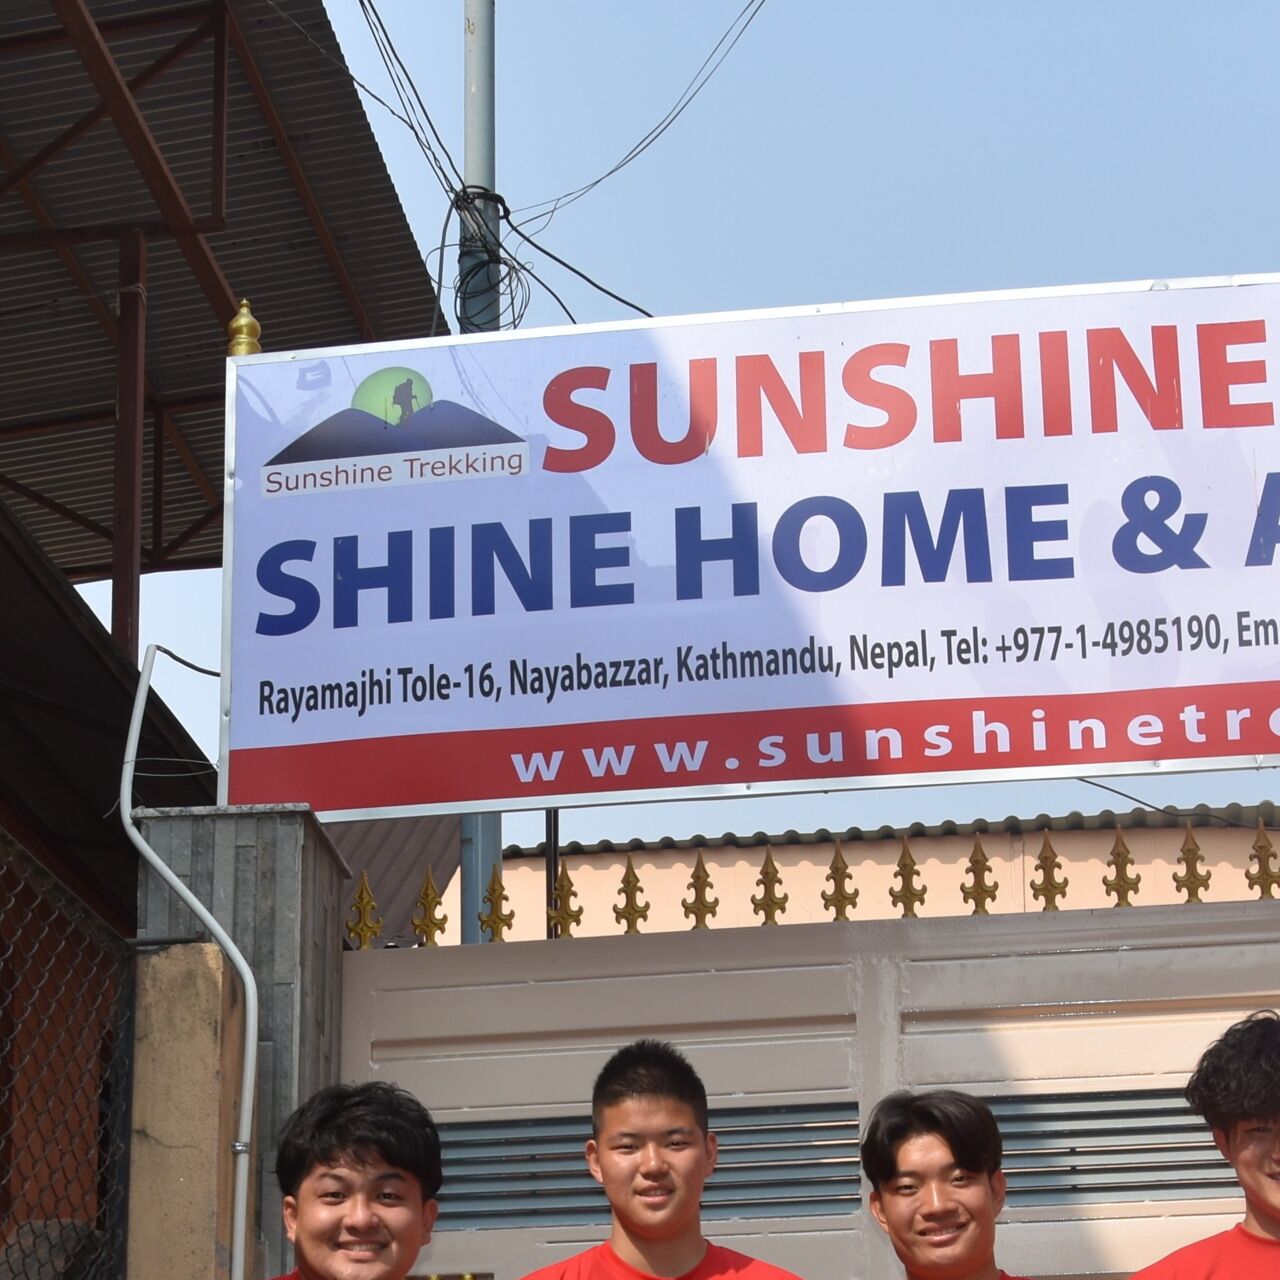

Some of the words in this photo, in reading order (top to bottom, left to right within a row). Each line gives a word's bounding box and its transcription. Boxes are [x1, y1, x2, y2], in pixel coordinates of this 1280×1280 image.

[543, 319, 1275, 474] SUNSHINE
[266, 464, 393, 494] Sunshine
[403, 452, 523, 479] Trekking
[256, 512, 634, 636] SHINE
[675, 484, 1074, 600] HOME
[1113, 476, 1209, 573] &
[260, 668, 391, 723] Rayamajhi
[398, 663, 501, 702] Tole-16,
[510, 653, 668, 704] Nayabazzar,
[677, 636, 841, 682] Kathmandu,
[850, 630, 935, 678] Nepal,
[941, 627, 987, 664] Tel:
[996, 615, 1228, 662] +977-1-4985190,
